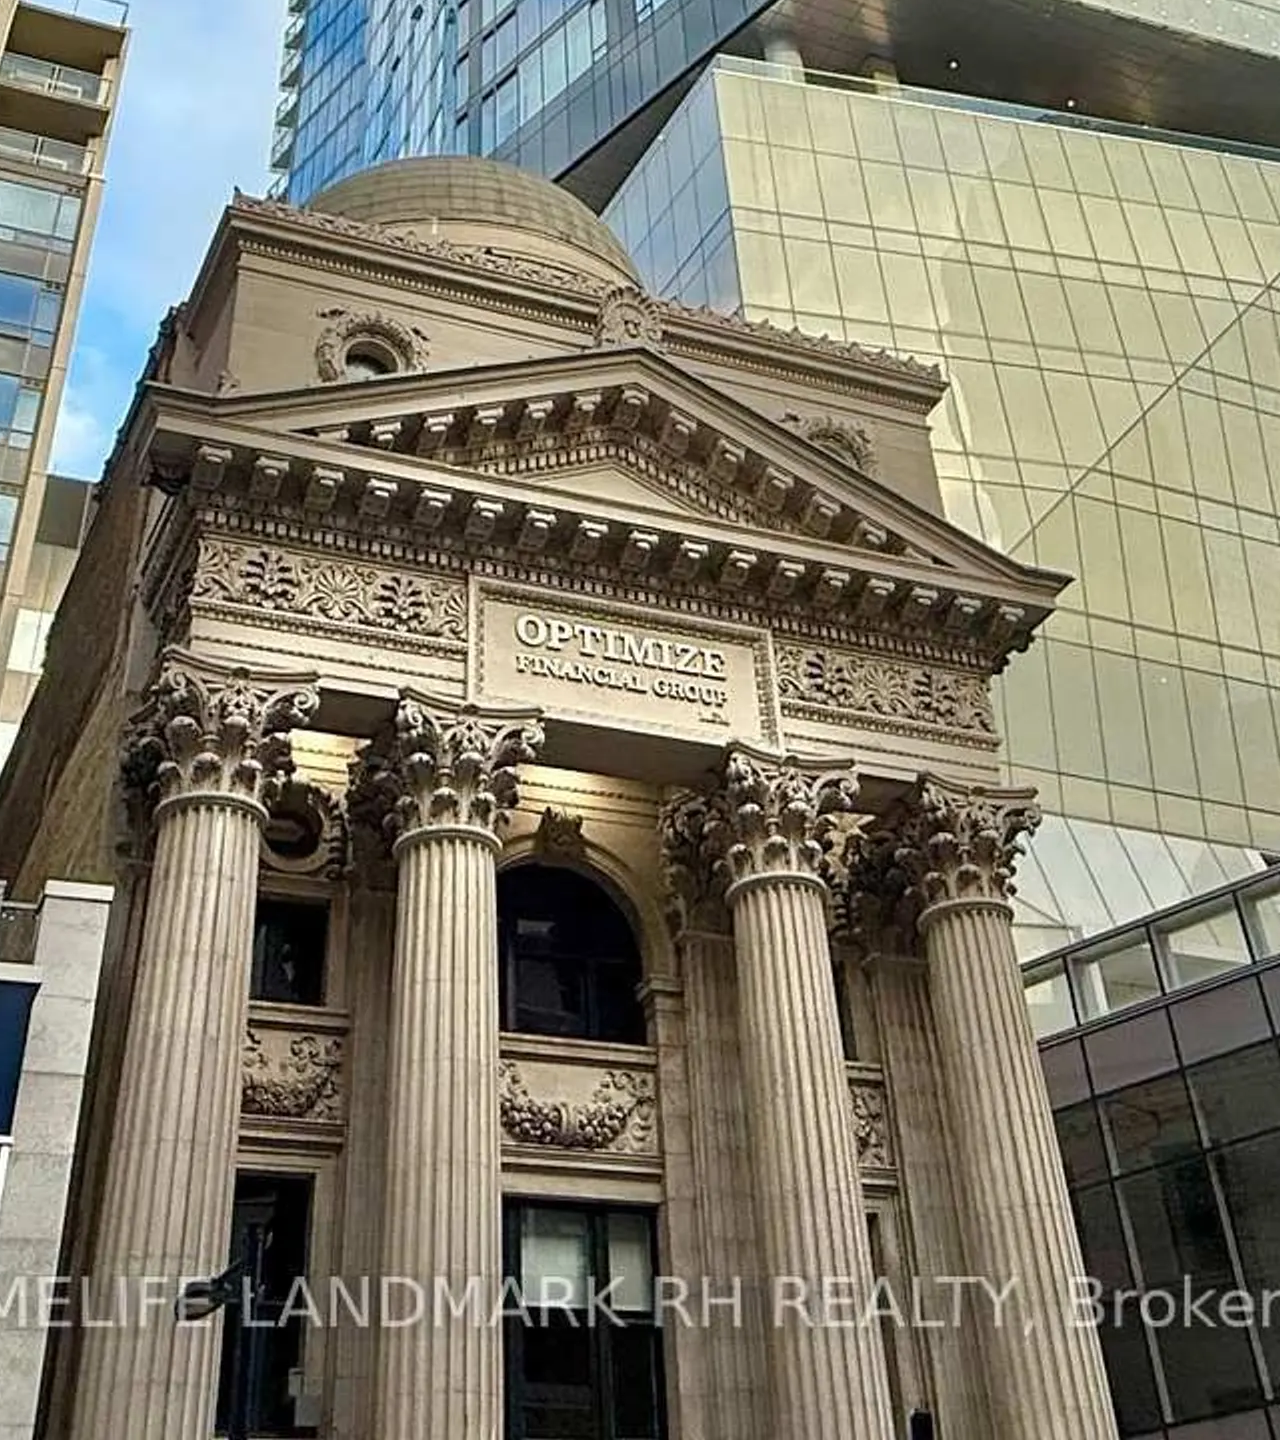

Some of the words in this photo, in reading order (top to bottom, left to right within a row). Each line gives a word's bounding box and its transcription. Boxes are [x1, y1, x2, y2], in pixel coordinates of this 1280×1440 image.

[516, 614, 727, 680] OPTIMIZE
[517, 655, 648, 694] FINANCIAL
[651, 675, 728, 707] GROUP
